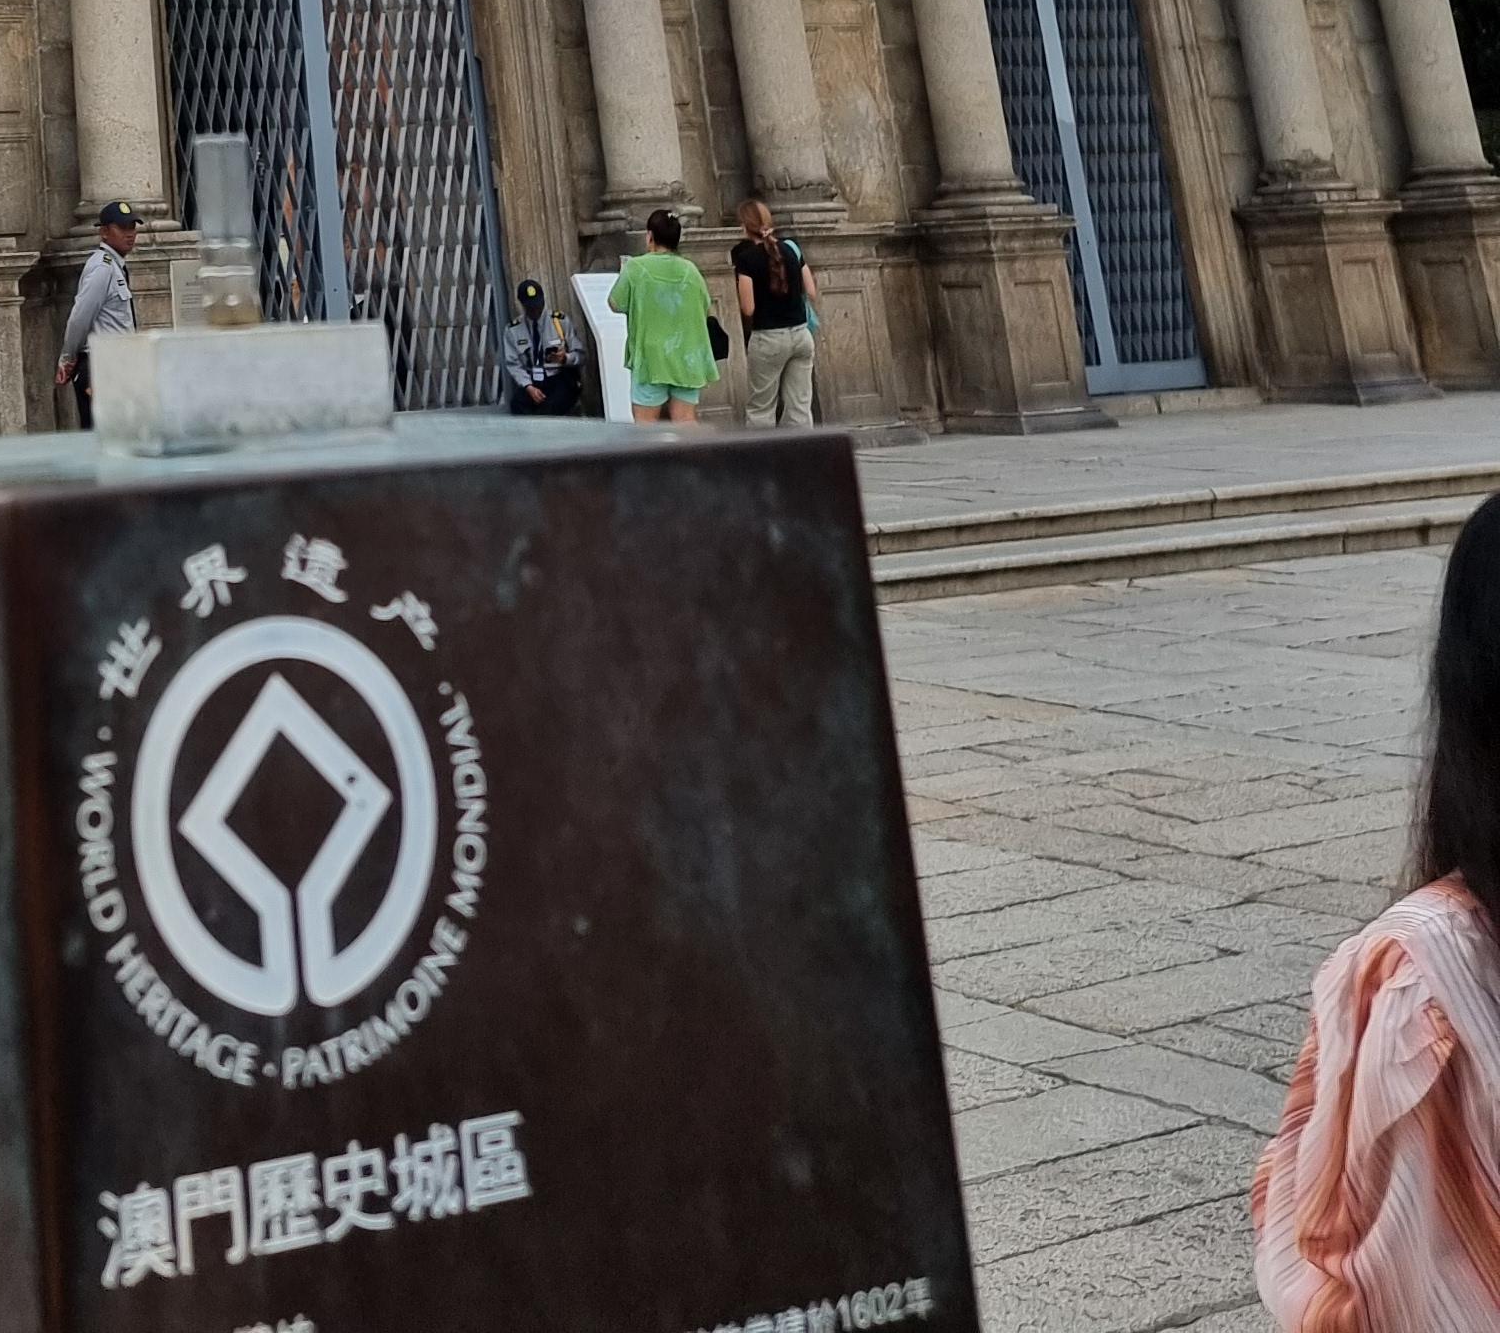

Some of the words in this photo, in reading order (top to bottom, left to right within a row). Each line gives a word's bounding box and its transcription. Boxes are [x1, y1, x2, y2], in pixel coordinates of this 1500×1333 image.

[76, 751, 127, 932] WORLD
[105, 933, 260, 1087] HERITAGE
[280, 914, 468, 1090] PATRIMOINE
[437, 690, 490, 918] MONDIAL
